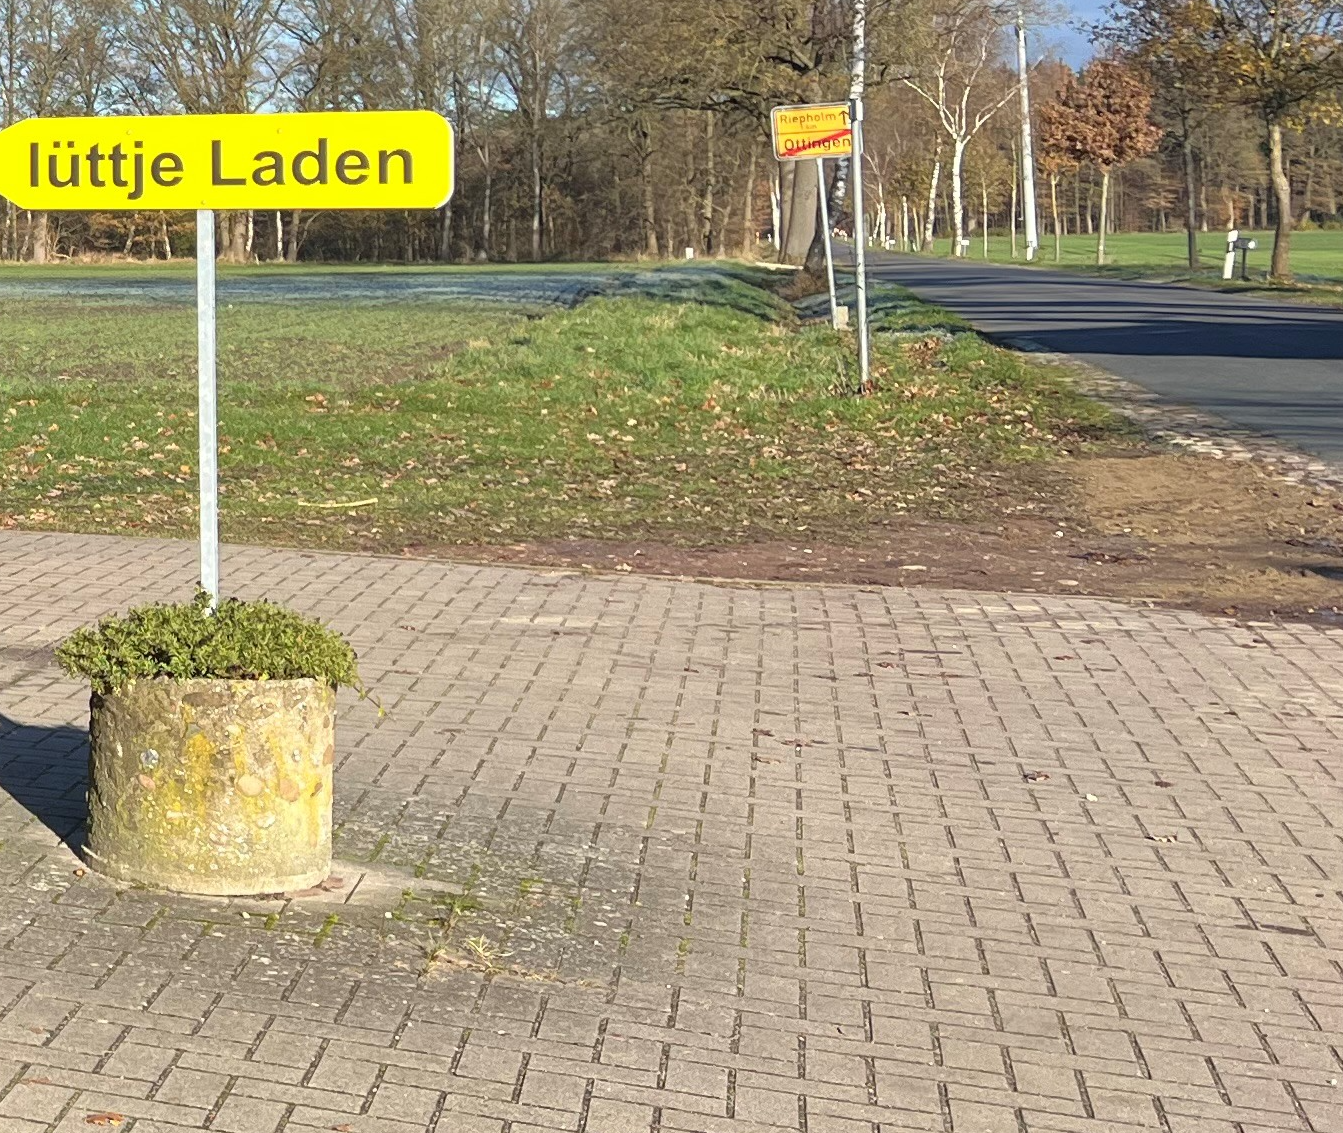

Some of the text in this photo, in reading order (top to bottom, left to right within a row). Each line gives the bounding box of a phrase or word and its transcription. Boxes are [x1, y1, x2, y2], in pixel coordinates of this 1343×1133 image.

[780, 112, 836, 125] Riepholm
[784, 138, 851, 151] Ottingen
[28, 138, 414, 200] lüttje Laden
